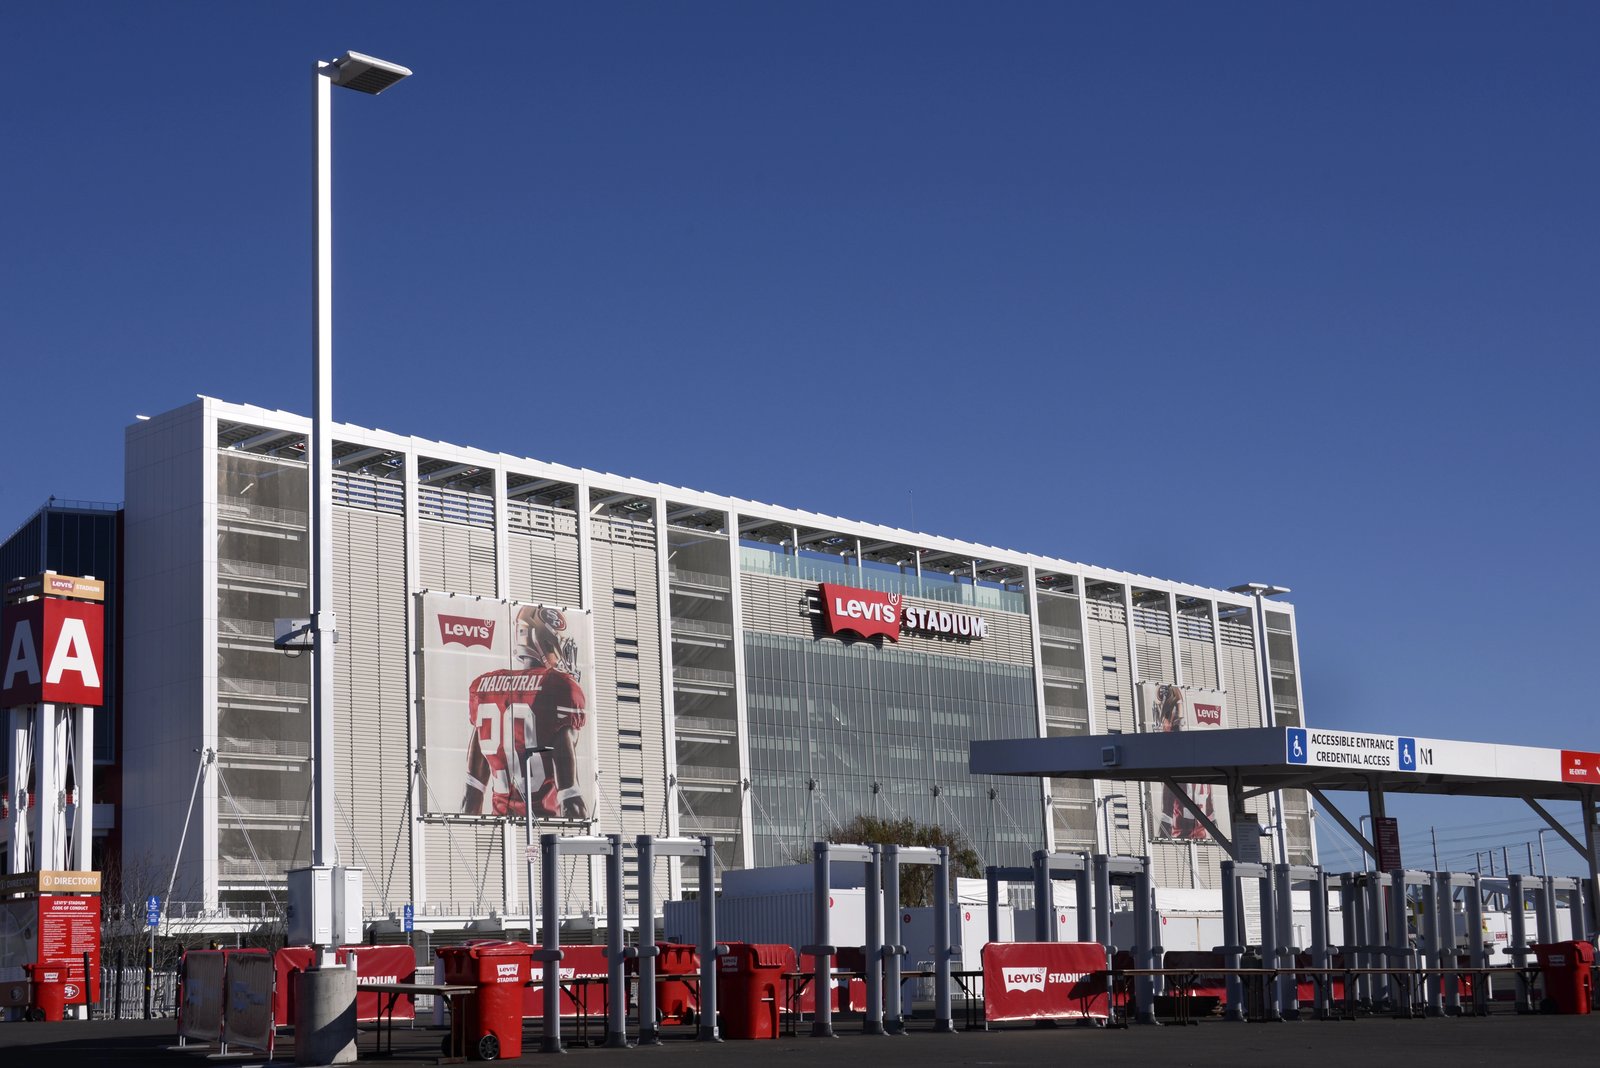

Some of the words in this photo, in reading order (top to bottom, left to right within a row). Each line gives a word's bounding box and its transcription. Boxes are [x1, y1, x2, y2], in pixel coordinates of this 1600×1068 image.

[906, 608, 985, 637] STADIUM
[3, 619, 41, 690] A
[46, 618, 100, 687] A
[477, 674, 542, 692] INAUGURAL
[1312, 734, 1355, 747] ACCESSIBLE
[1357, 738, 1394, 750] ENTRANCE
[1316, 751, 1361, 764] CREDENTIAL
[1363, 755, 1390, 766] ACCESS
[1420, 748, 1433, 765] N1
[357, 975, 397, 985] TADIUM
[1049, 972, 1091, 984] STADIUM
